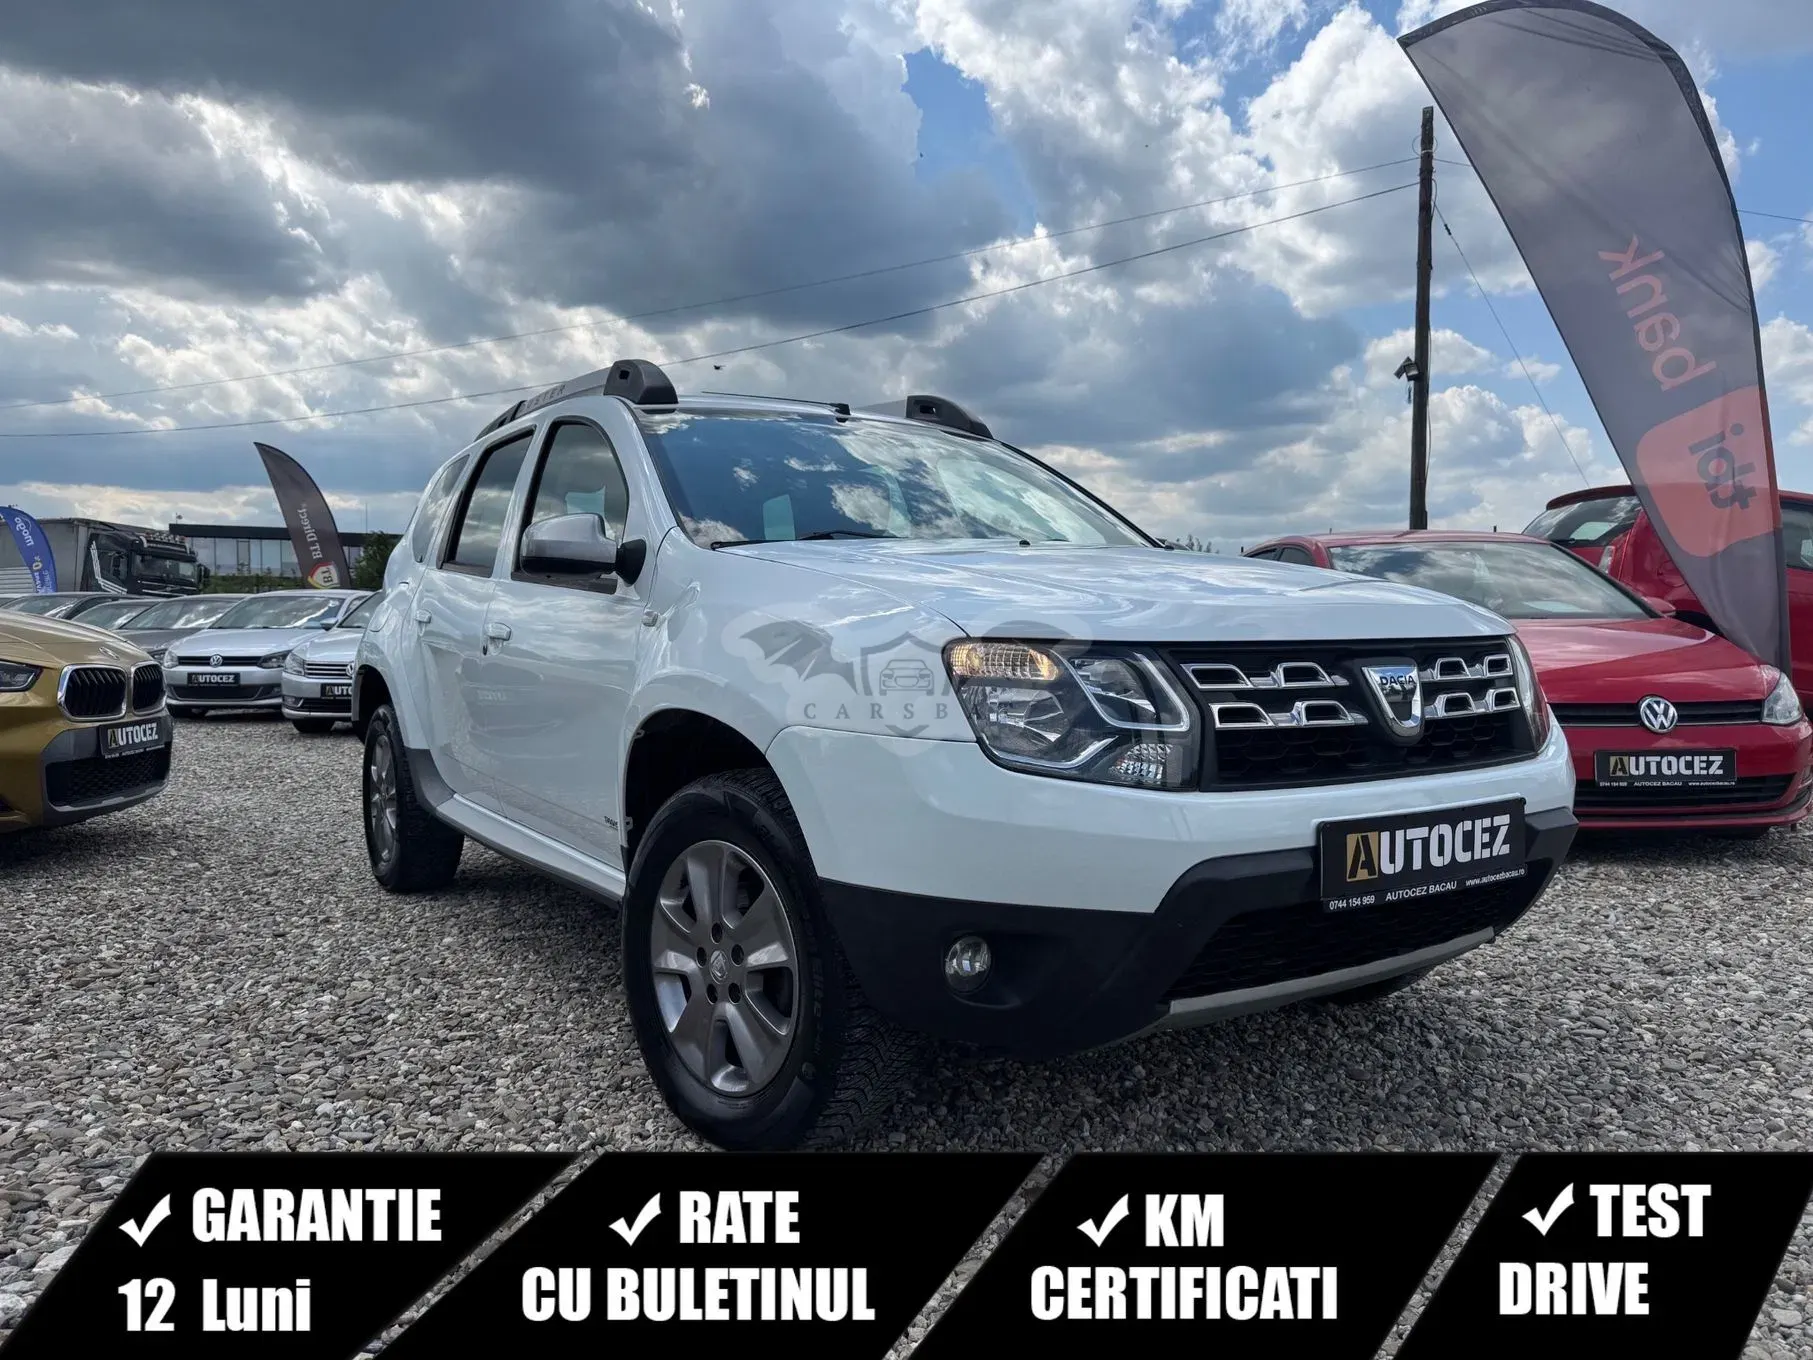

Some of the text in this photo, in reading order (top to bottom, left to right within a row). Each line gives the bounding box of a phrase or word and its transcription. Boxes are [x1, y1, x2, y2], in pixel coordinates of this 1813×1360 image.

[192, 674, 235, 684] AUTOCEZ
[1379, 675, 1416, 686] DACIA
[108, 722, 159, 749] AUTOCEZ
[1609, 755, 1724, 776] AUTOCEZ
[1346, 813, 1511, 883] AUTOCEZ
[1329, 899, 1347, 910] 0744
[1348, 896, 1361, 907] 154
[1362, 894, 1375, 905] 959
[1385, 886, 1427, 901] AUTOCEZ
[1428, 881, 1457, 894] BACAU
